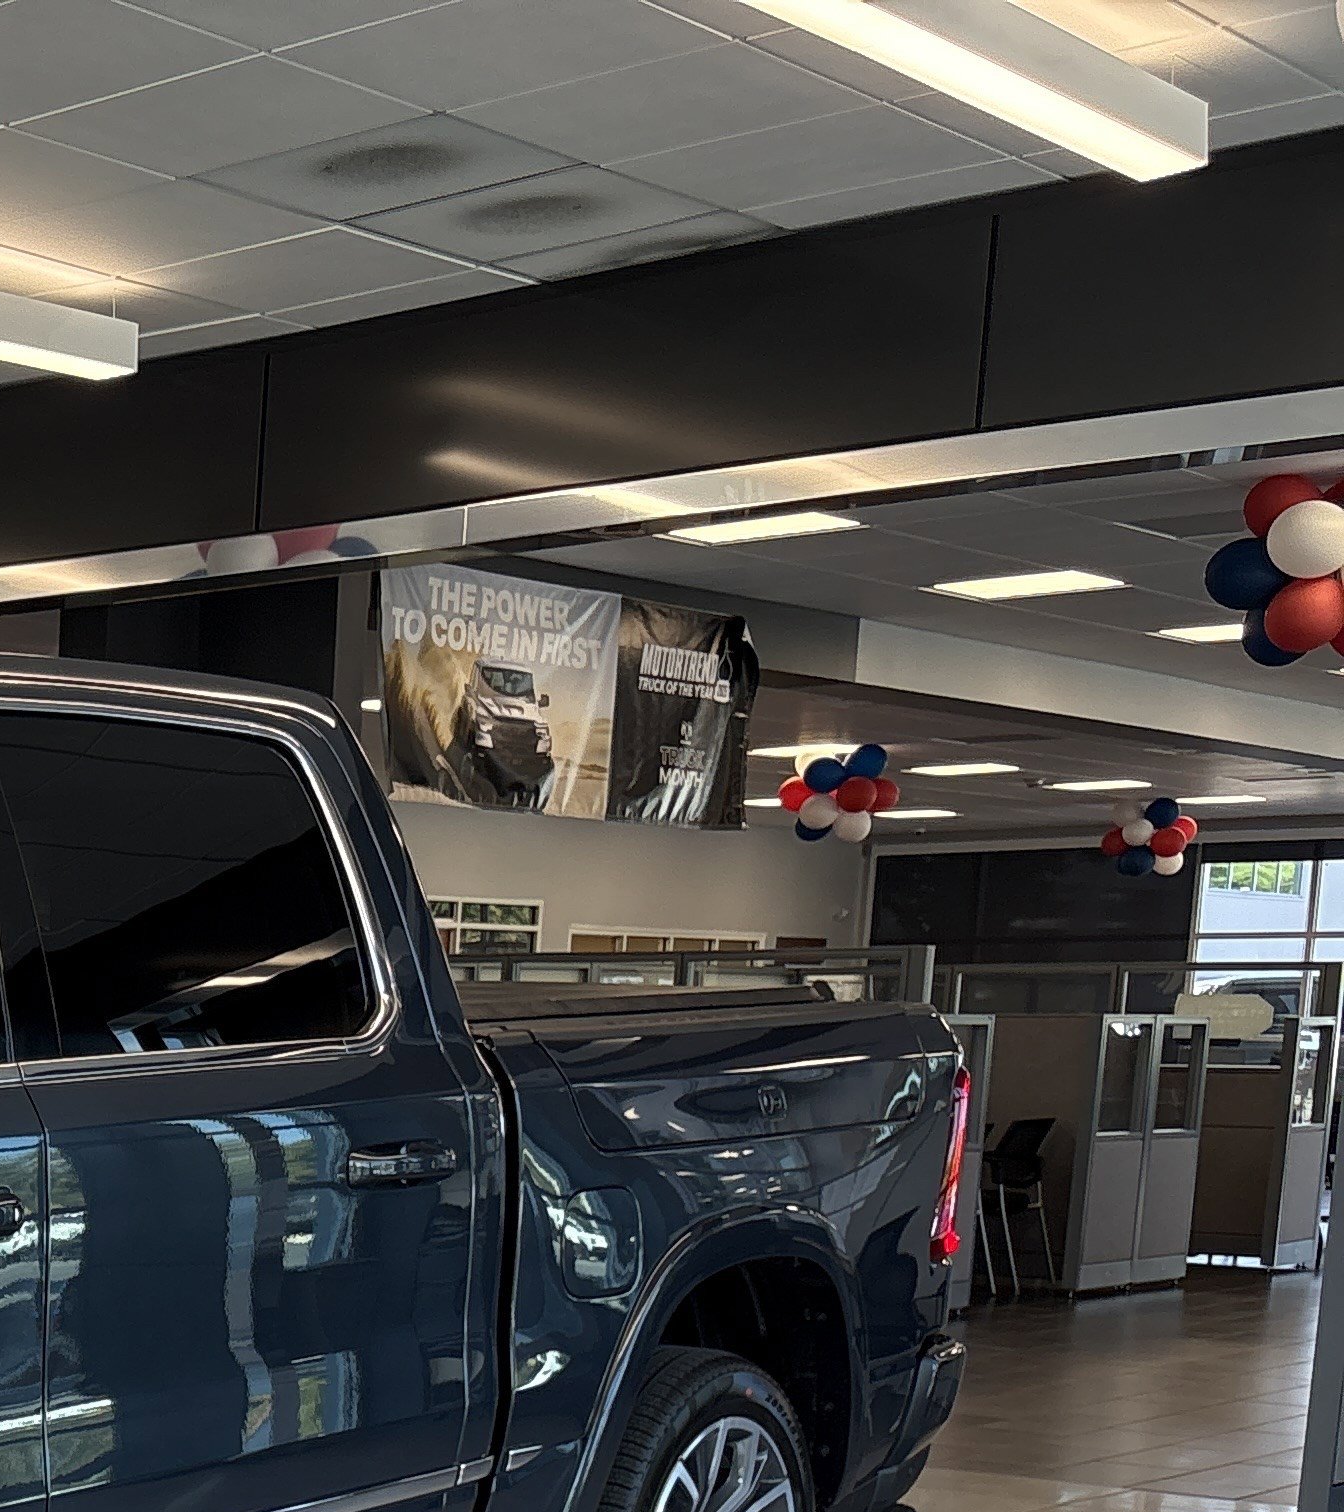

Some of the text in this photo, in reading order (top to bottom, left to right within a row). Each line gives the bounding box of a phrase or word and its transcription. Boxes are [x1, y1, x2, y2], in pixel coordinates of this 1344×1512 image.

[428, 576, 571, 631] THE POWER
[392, 606, 602, 670] TO COME IN FIRST
[640, 642, 720, 685] MOTORTREND
[638, 676, 666, 694] TRUCK
[666, 680, 678, 695] OF
[678, 681, 694, 698] THE
[694, 684, 714, 700] YEAR
[659, 745, 706, 770] TRUCK
[659, 766, 705, 788] MONTH
